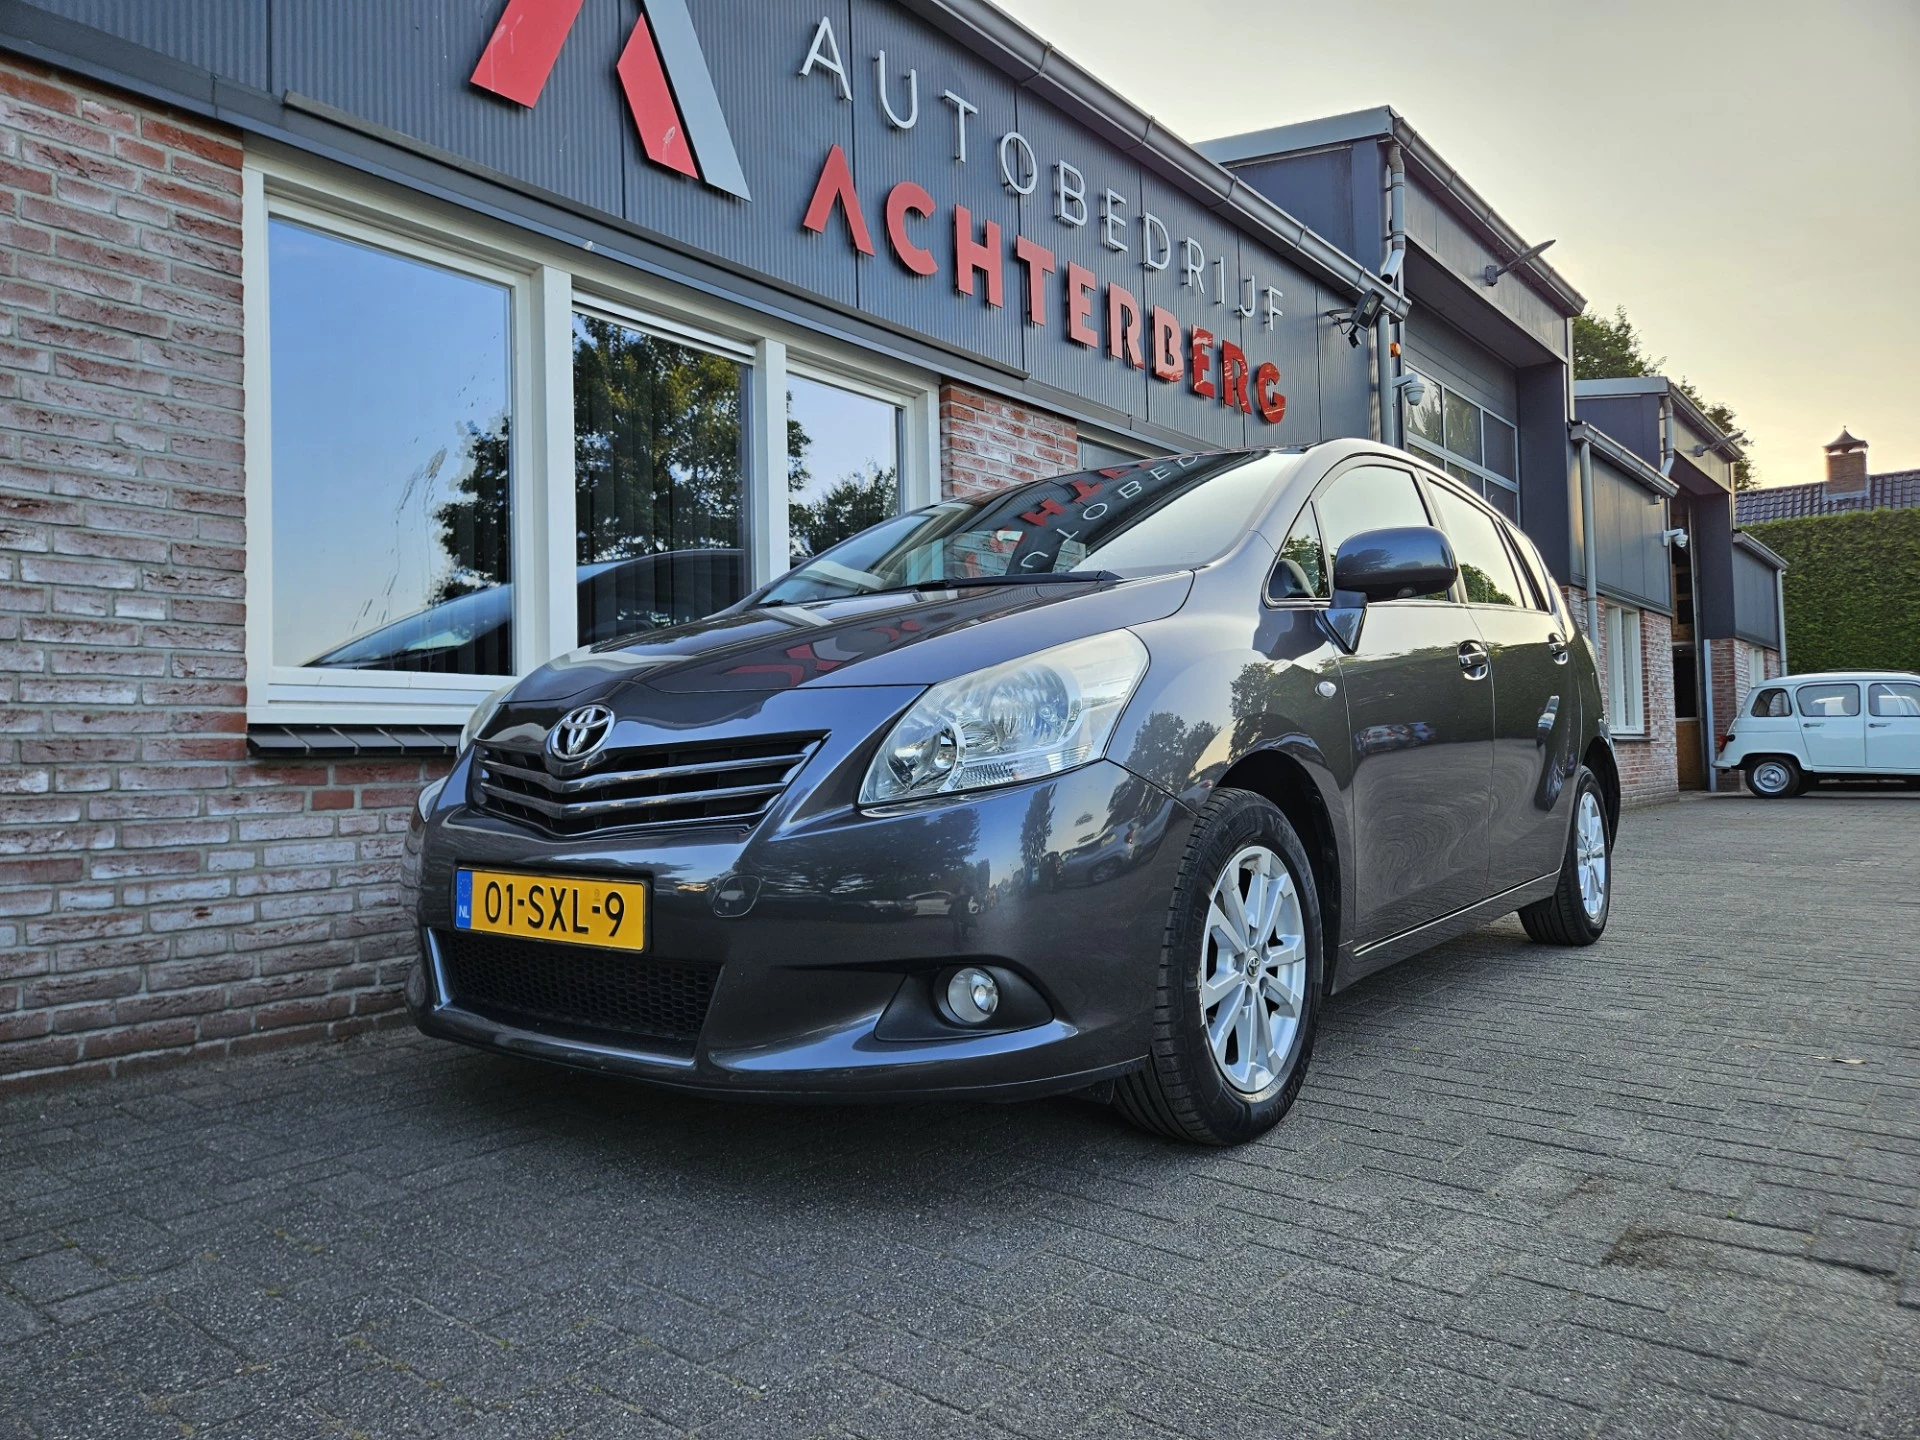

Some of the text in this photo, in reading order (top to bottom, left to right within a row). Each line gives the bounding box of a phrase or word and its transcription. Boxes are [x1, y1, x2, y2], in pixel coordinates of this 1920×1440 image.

[799, 15, 1285, 332] AUTOBEDRIJF
[802, 143, 1288, 425] ACHTERBERG
[458, 880, 626, 938] NL 01-SXL-9
